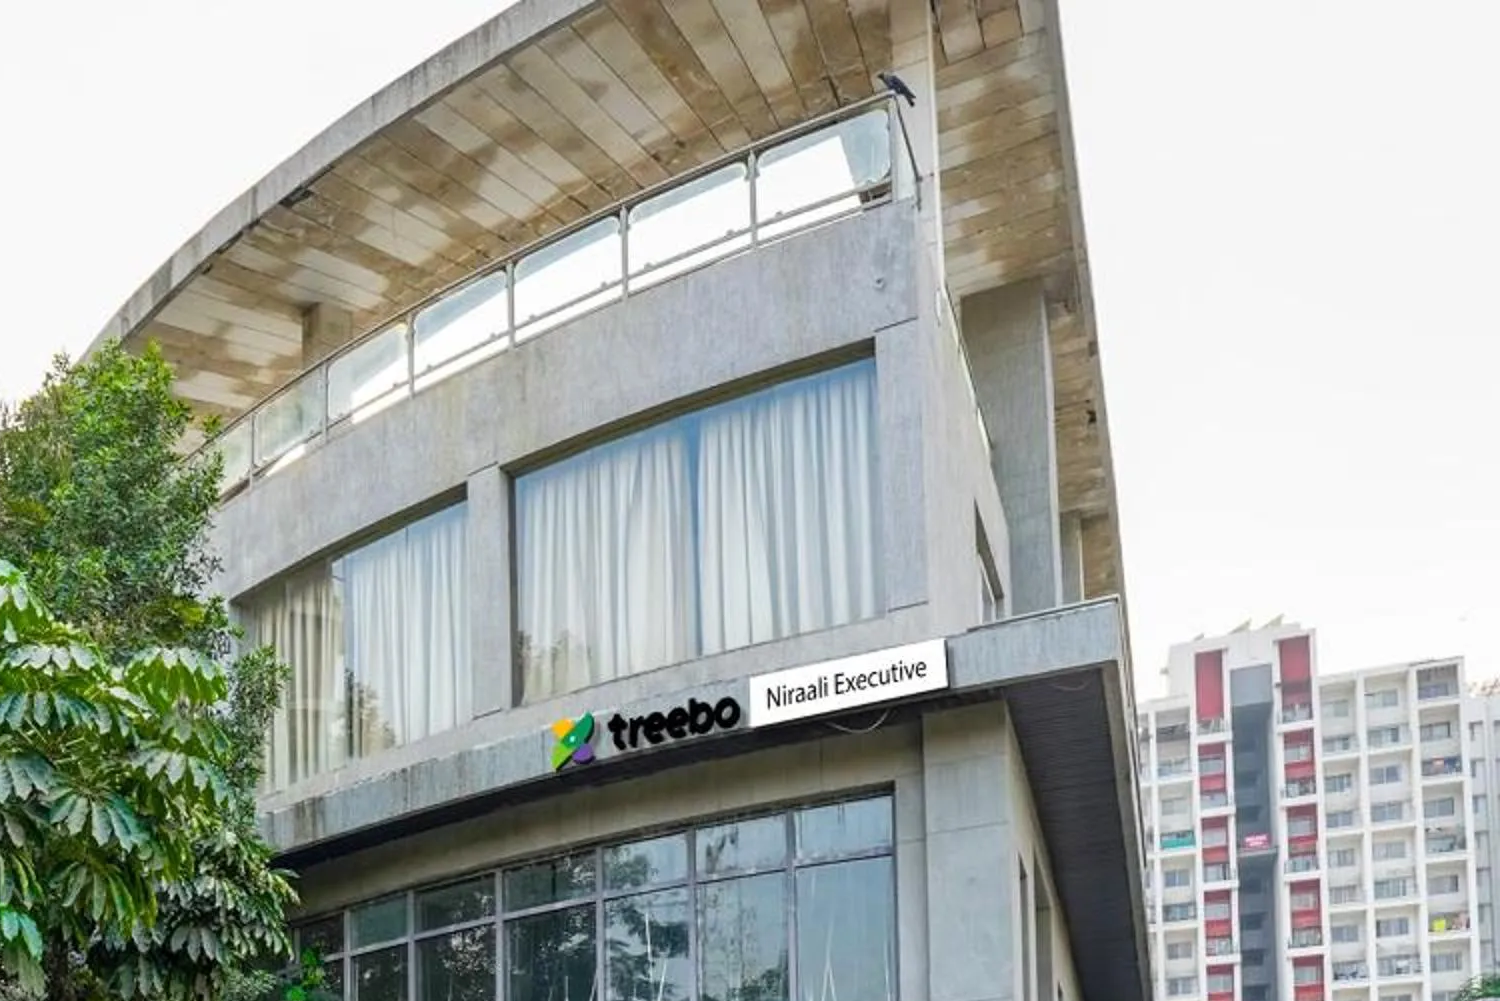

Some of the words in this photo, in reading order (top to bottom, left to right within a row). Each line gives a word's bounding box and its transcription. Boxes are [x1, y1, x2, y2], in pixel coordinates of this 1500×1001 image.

[766, 676, 829, 710] Niraali
[835, 659, 928, 696] Executive
[607, 696, 741, 751] treebo
